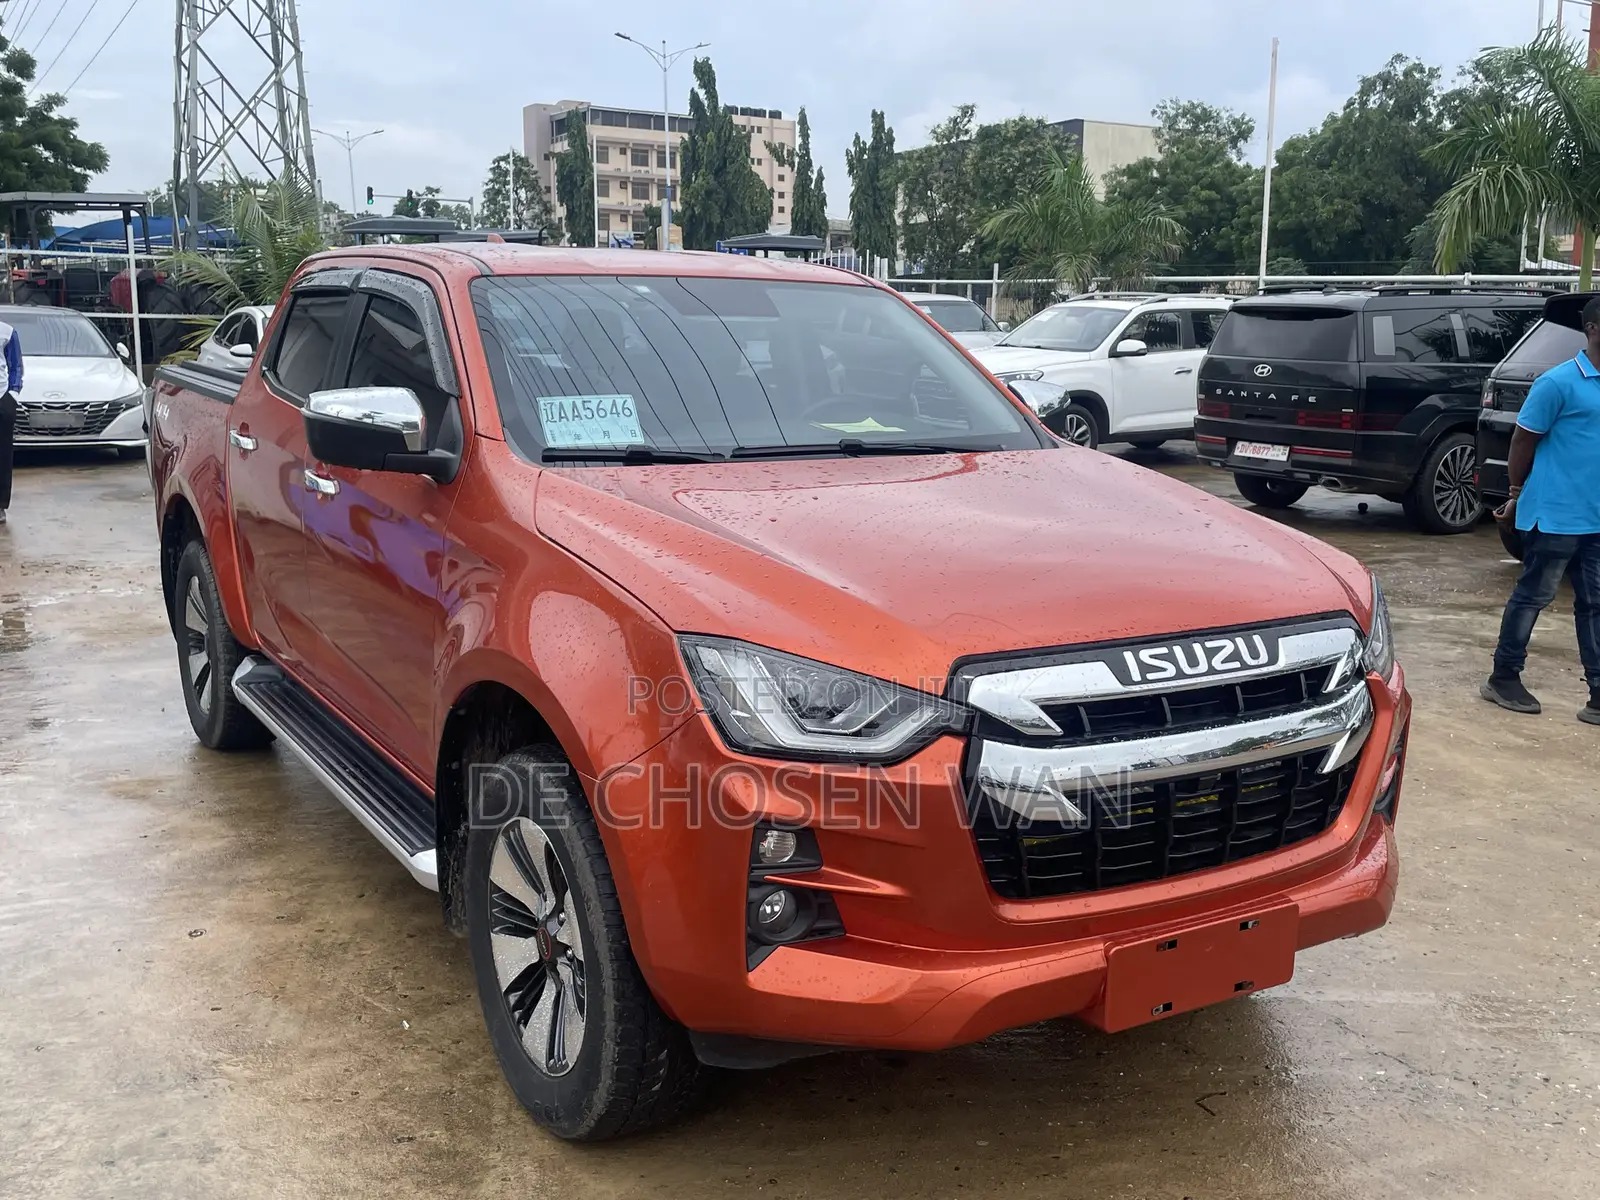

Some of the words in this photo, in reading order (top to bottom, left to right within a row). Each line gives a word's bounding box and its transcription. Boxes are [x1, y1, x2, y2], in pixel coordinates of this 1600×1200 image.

[1215, 388, 1277, 400] SANTA
[1291, 395, 1317, 403] FE
[543, 399, 633, 423] 辽AA5646
[602, 430, 611, 439] 月
[629, 429, 638, 438] 日
[1123, 634, 1269, 682] ISUZU
